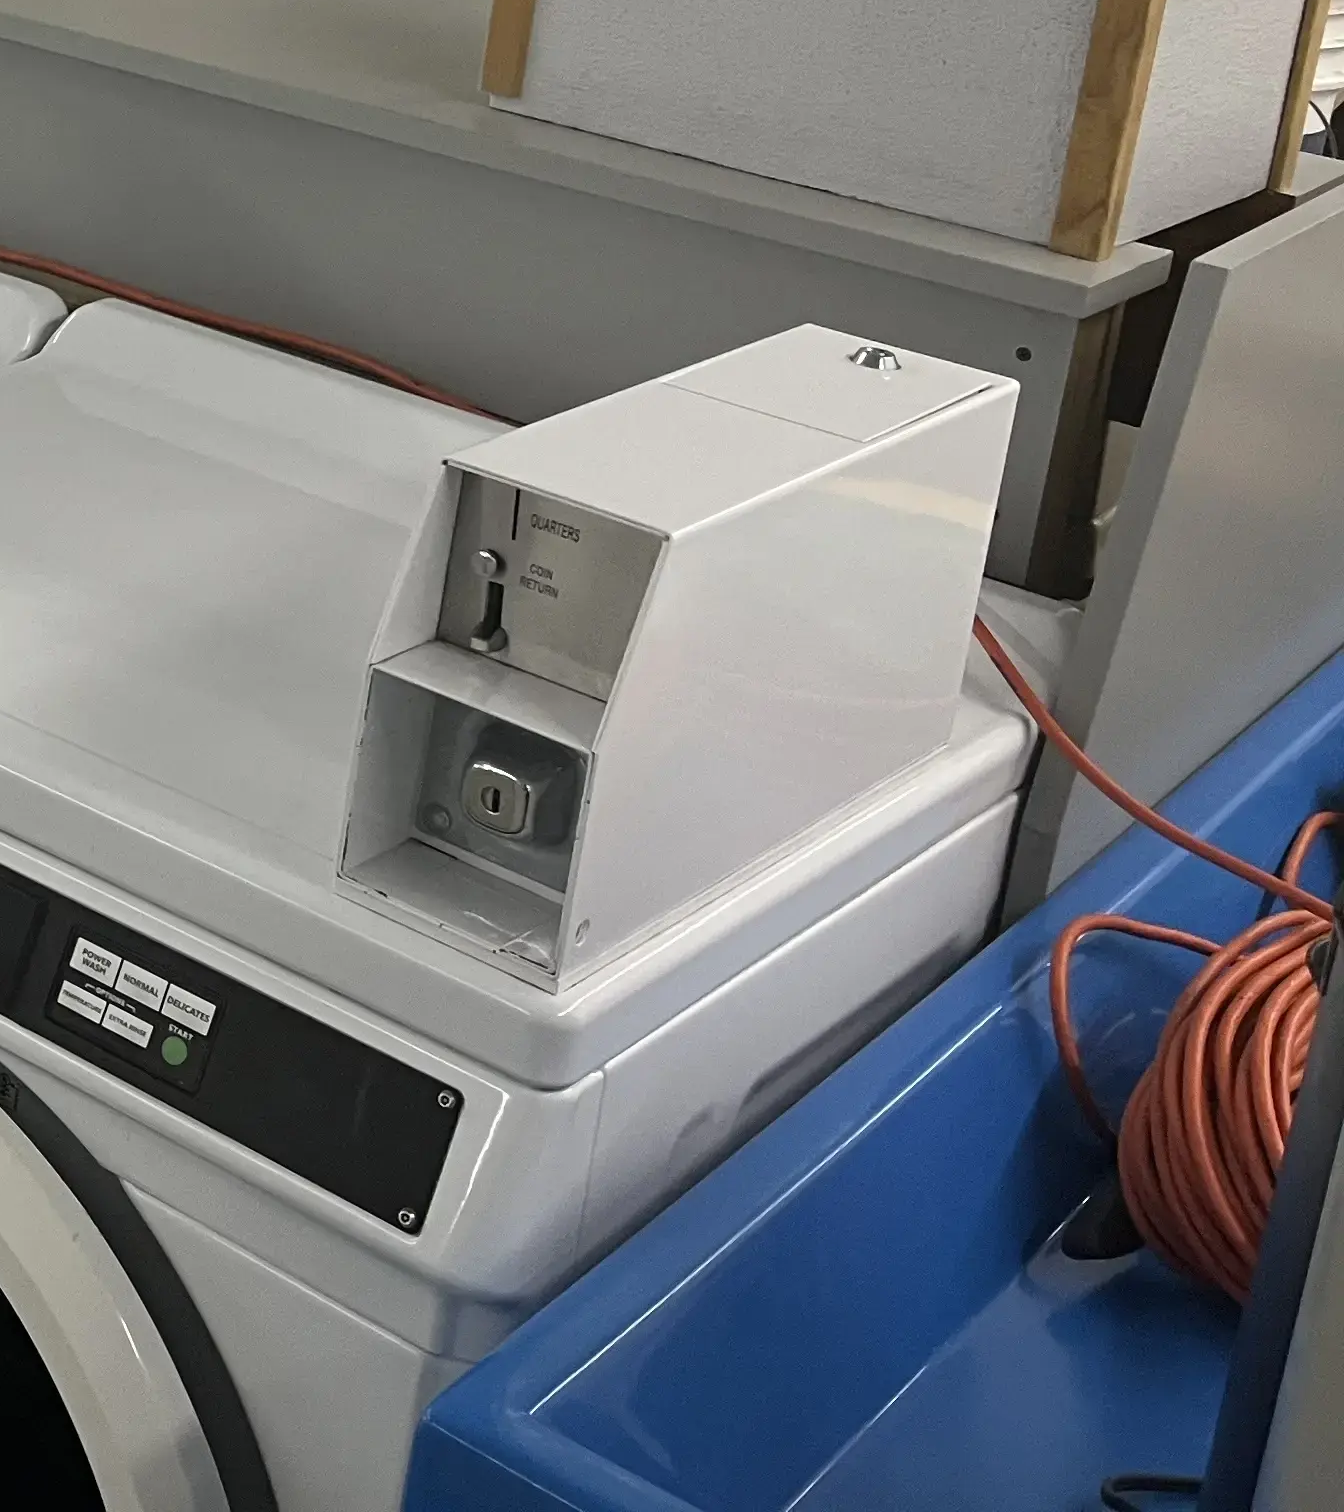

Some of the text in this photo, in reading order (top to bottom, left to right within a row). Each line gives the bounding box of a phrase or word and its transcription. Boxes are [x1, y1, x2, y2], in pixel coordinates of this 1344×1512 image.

[531, 513, 581, 543] QUARTERS
[529, 563, 554, 581] COIN
[520, 575, 559, 599] RETURN
[82, 947, 112, 968] POWER
[82, 957, 107, 976] WASH
[123, 972, 159, 998] NORMAL
[167, 995, 211, 1024] DELICATES
[168, 1023, 194, 1041] START
